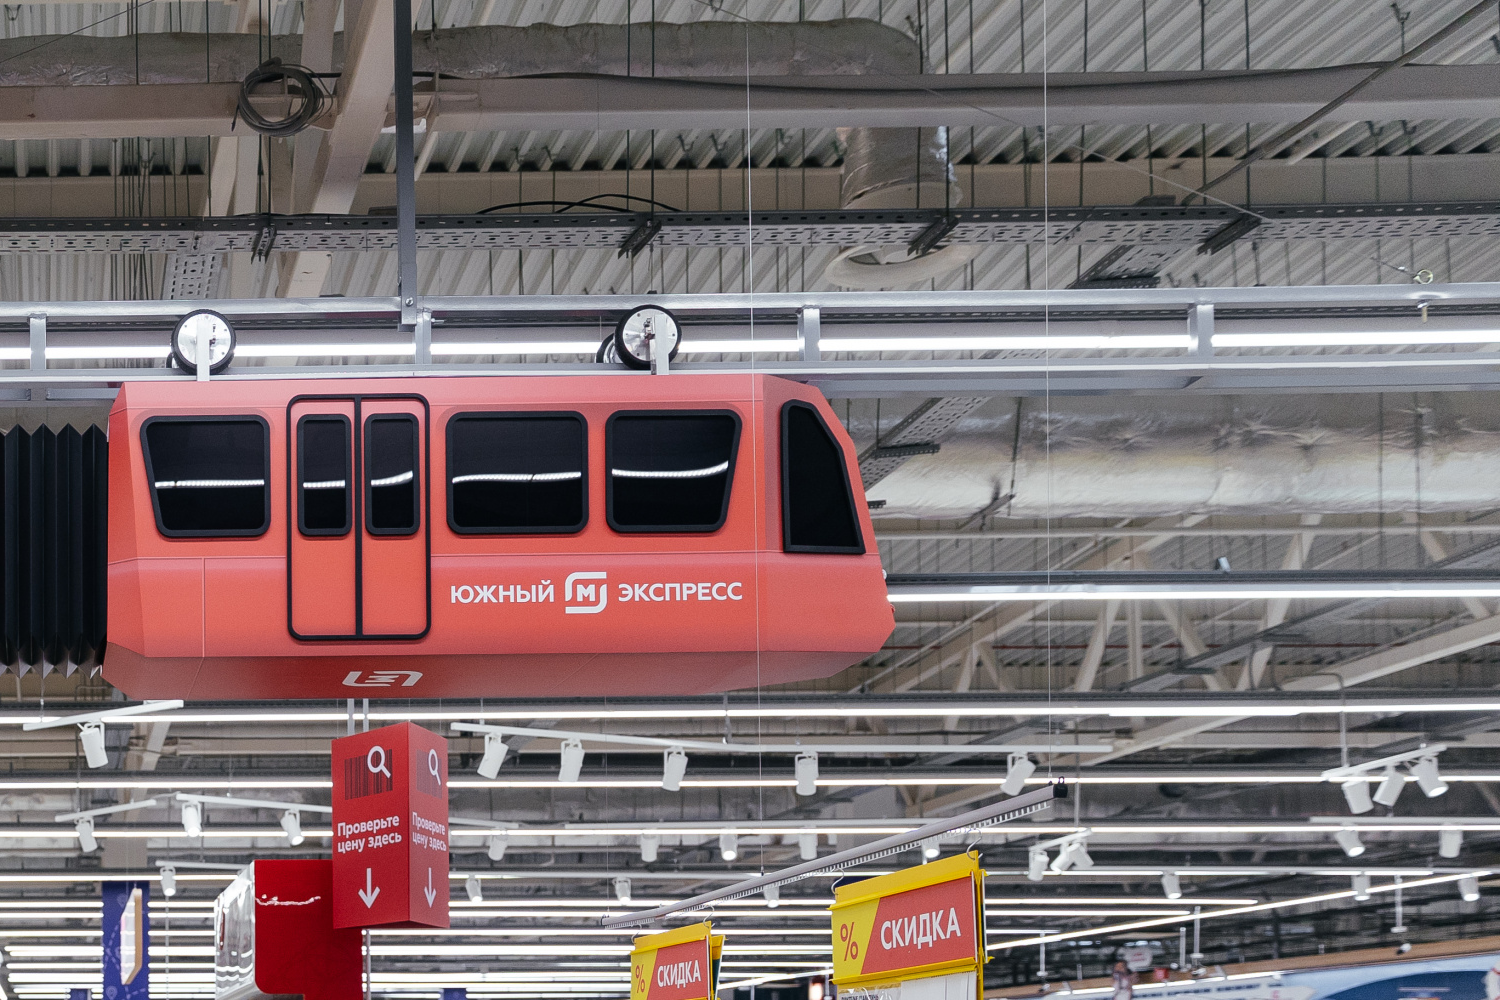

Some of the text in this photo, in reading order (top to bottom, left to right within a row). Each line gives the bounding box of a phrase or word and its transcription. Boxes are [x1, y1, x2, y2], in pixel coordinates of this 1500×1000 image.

[450, 579, 554, 603] ЮЖНЫЙ
[619, 582, 743, 602] ЭКСПРЕСС
[337, 815, 400, 838] Проверьте
[412, 811, 445, 835] Проверьте
[337, 832, 402, 854] цену здесь
[412, 831, 447, 852] цену здесь
[880, 907, 961, 950] СКИДКА
[657, 959, 701, 989] СКИДКА
